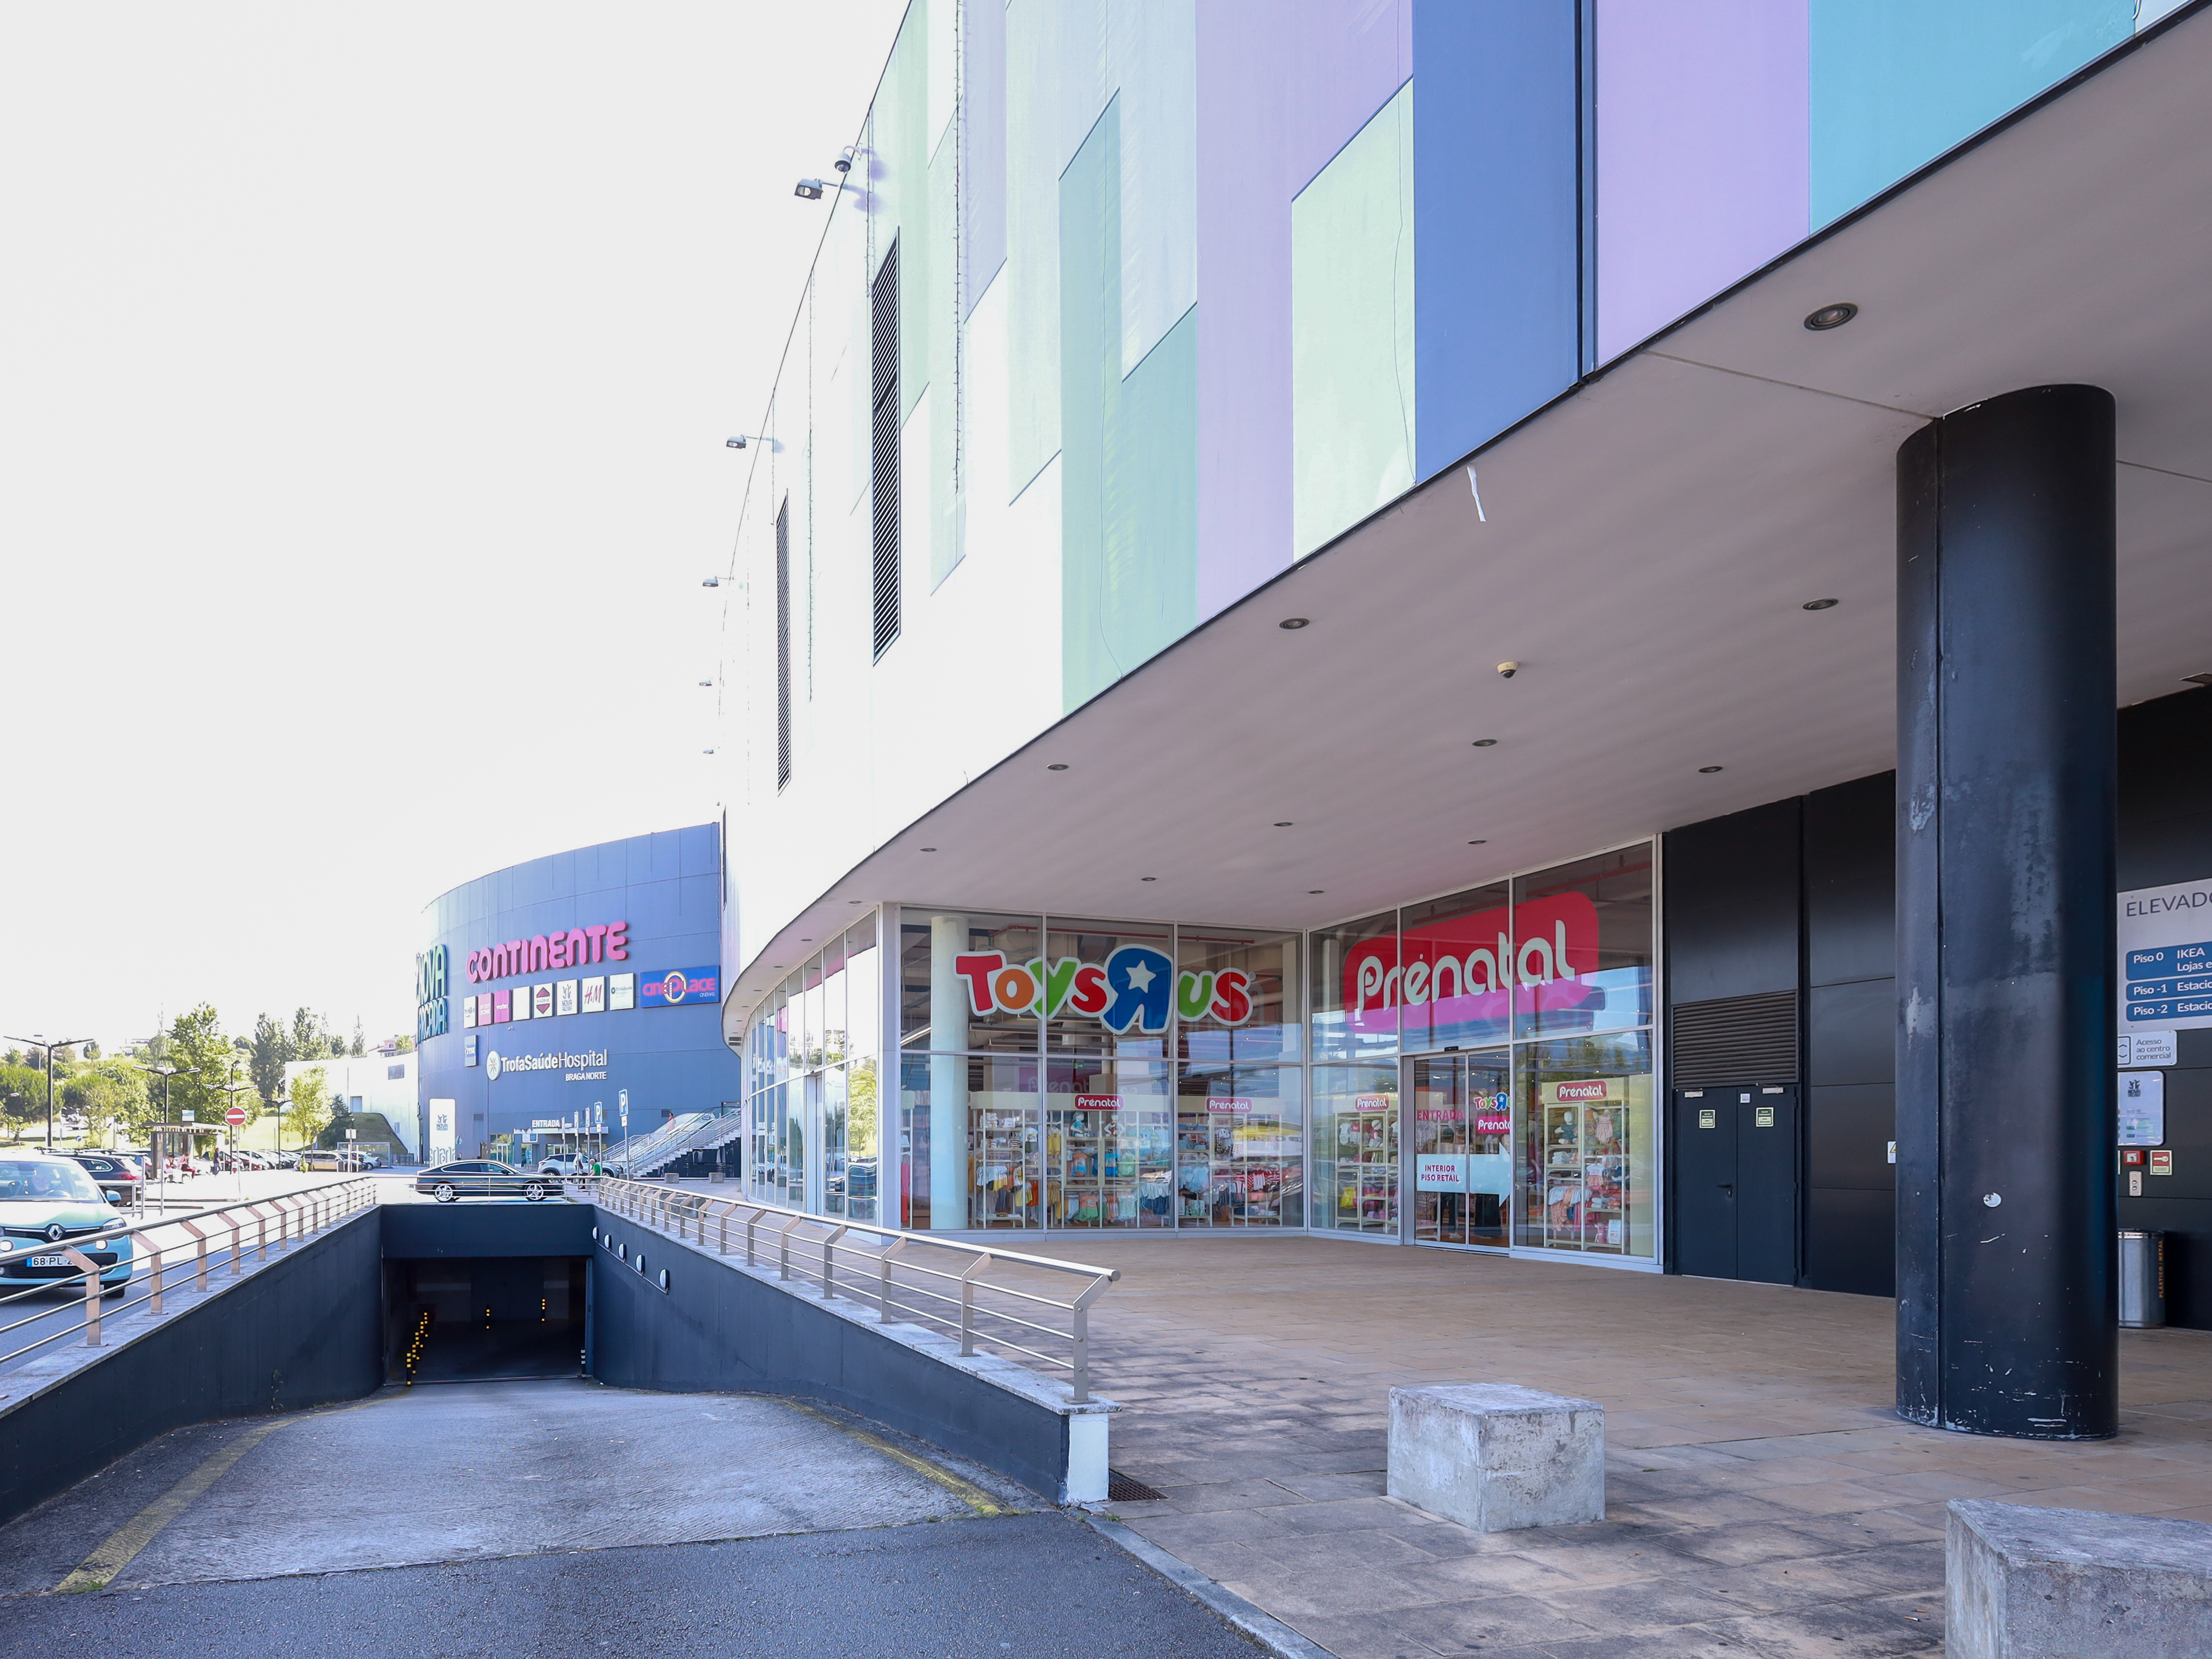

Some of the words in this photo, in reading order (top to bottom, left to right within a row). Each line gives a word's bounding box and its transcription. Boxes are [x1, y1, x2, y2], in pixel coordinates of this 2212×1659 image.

[2127, 892, 2212, 917] ELEVAD
[2134, 954, 2154, 964] Piso
[2156, 952, 2164, 961] 0
[2177, 947, 2206, 959] IKEA
[1357, 920, 1575, 1014] Prénatal
[2177, 962, 2203, 973] Lojas
[418, 944, 447, 1006] NOVA
[2134, 986, 2154, 996] Piso
[2156, 984, 2167, 993] -1
[2134, 1006, 2155, 1016] Piso
[2157, 1004, 2168, 1014] -2
[417, 997, 447, 1045] ARCADA
[2136, 1052, 2171, 1060] comercial
[1560, 1084, 1603, 1098] Prénatal
[1078, 1097, 1121, 1108] Prénatal
[1209, 1100, 1249, 1110] Prénatal
[1417, 1109, 1465, 1121] ENTRADA
[532, 1120, 561, 1128] ENTRADA
[1425, 1164, 1455, 1172] INTERIOR
[1437, 1174, 1459, 1182] RETAIL
